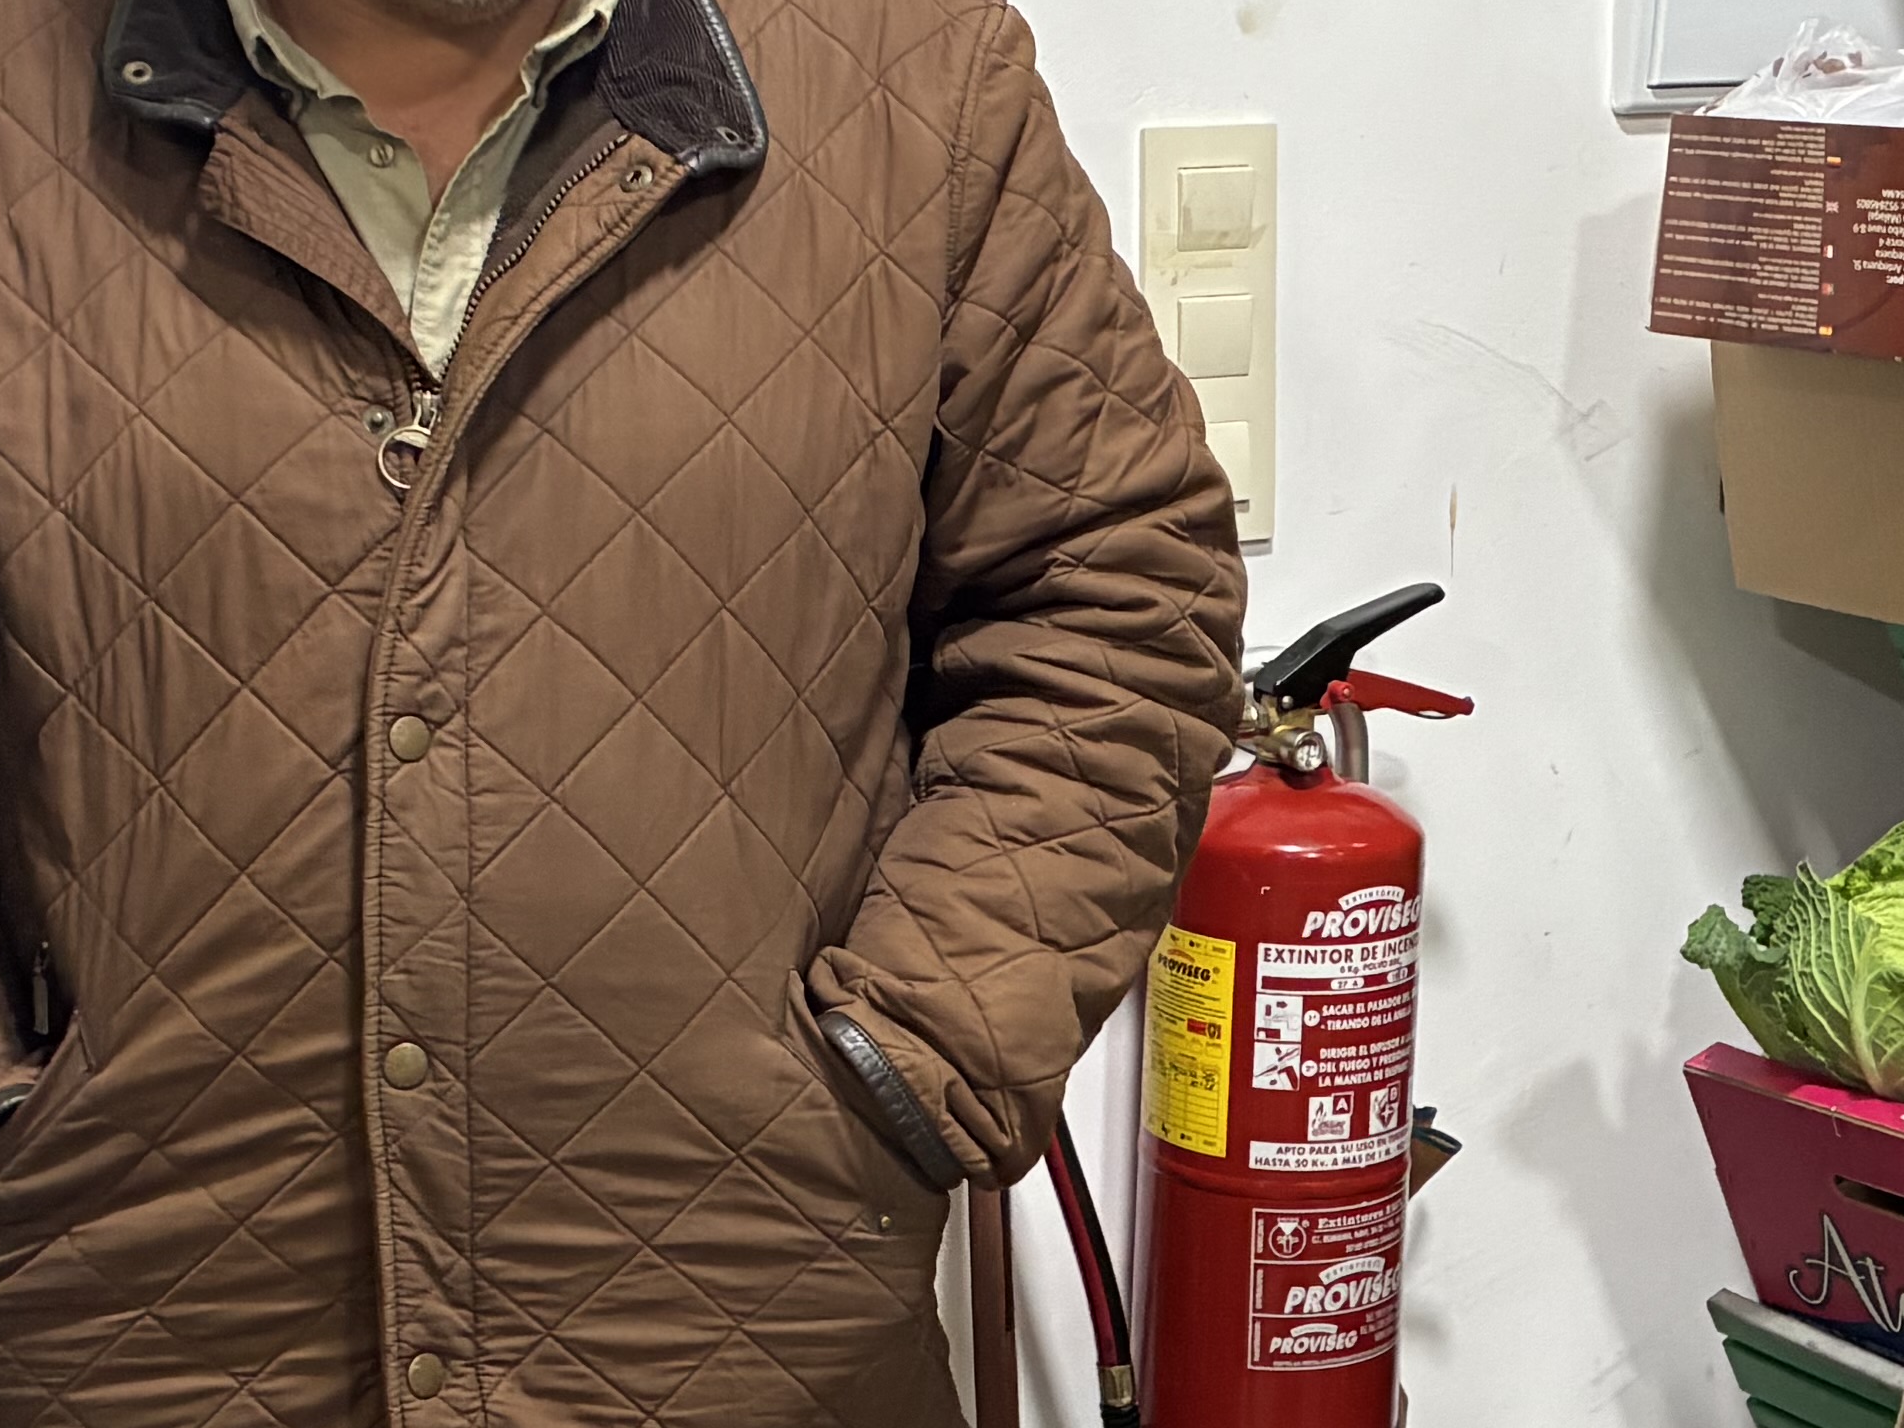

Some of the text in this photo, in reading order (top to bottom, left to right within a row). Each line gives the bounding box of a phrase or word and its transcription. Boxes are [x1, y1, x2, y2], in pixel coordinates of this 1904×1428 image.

[1862, 260, 1902, 274] Antequera
[1886, 274, 1904, 286] por:
[1263, 945, 1378, 964] EXTINTOR DE
[1157, 952, 1212, 982] PROVISEG
[1322, 997, 1402, 1017] SACAR EL PASADOR
[1327, 1017, 1370, 1030] TIRANDO
[1371, 1015, 1381, 1027] DE
[1383, 1012, 1392, 1022] LA
[1320, 1045, 1356, 1059] DIRIGIR
[1359, 1045, 1368, 1056] EL
[1319, 1062, 1336, 1073] DEL
[1339, 1058, 1370, 1072] FUEGO
[1372, 1057, 1378, 1068] Y
[1318, 1076, 1331, 1087] LA
[1333, 1073, 1372, 1086] MANETA
[1335, 1097, 1348, 1111] A
[1276, 1145, 1305, 1156] APTO
[1309, 1144, 1337, 1155] PARA
[1341, 1144, 1353, 1154] SU
[1356, 1140, 1374, 1152] USO
[1254, 1157, 1291, 1168] HASTA
[1294, 1157, 1308, 1167] 50
[1331, 1158, 1339, 1166] A
[1342, 1155, 1363, 1165] MAS
[1364, 1151, 1376, 1162] DE
[1269, 1329, 1358, 1354] PROVISEG
